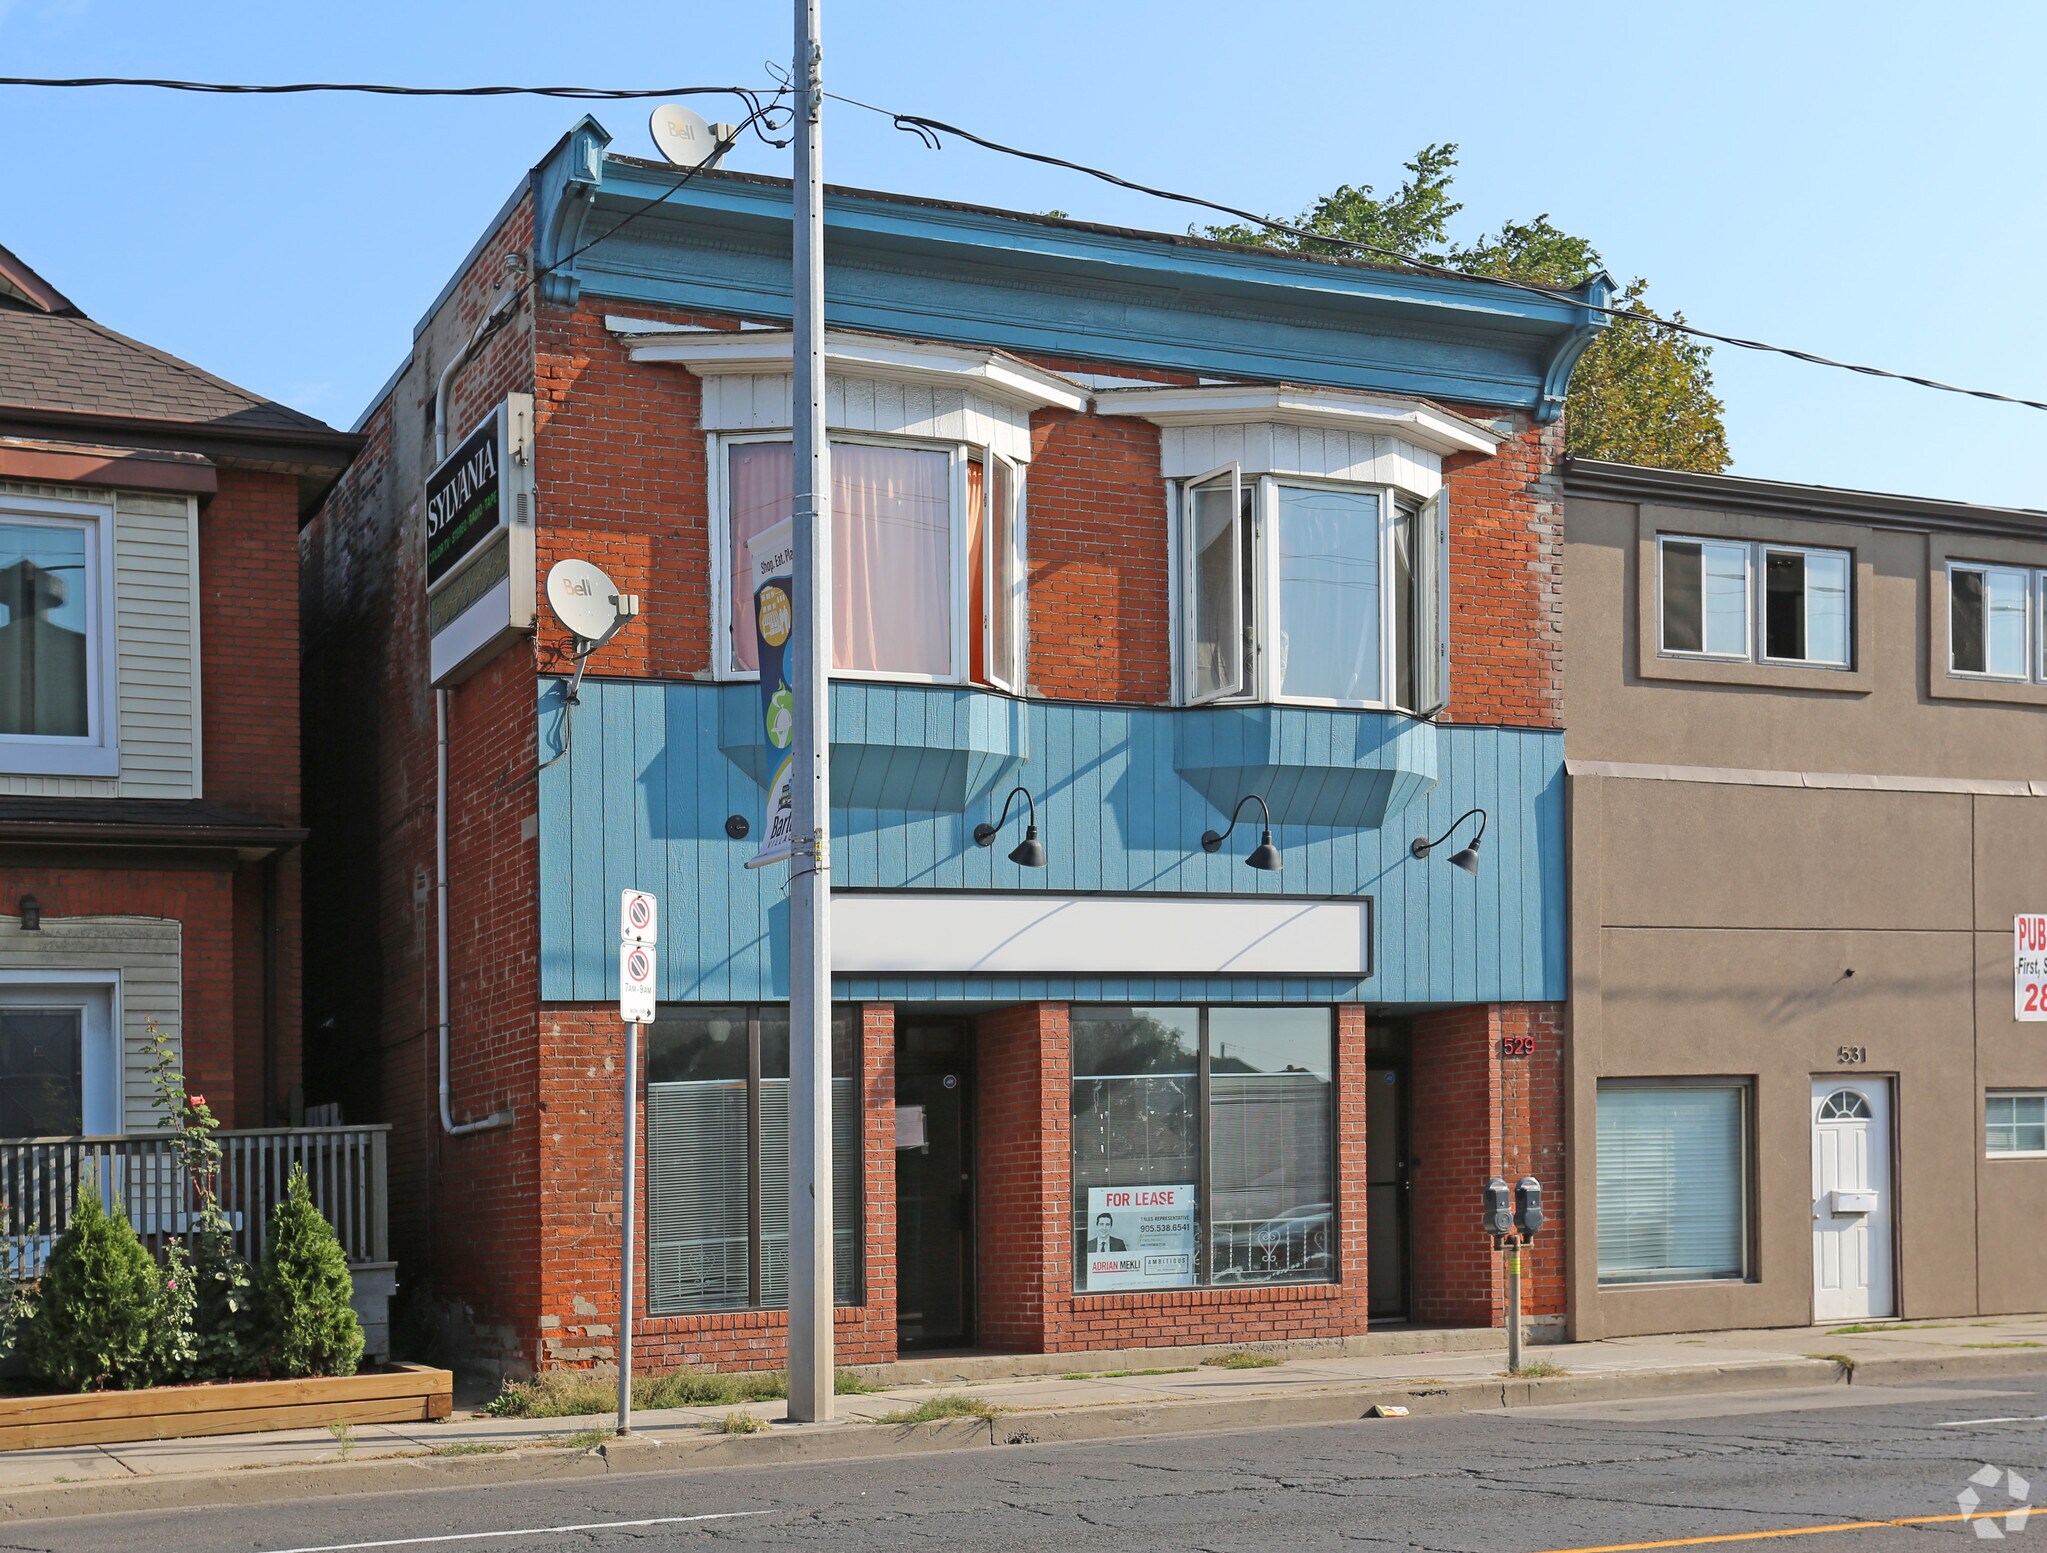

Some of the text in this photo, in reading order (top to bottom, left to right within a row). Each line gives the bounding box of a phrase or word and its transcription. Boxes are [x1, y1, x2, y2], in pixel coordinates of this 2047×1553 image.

[667, 120, 695, 141] Bell
[428, 439, 497, 539] SYLVANIA
[760, 560, 775, 575] Shop.
[774, 552, 785, 568] Eat.
[562, 577, 593, 597] Bell
[2018, 917, 2047, 951] PUB
[2017, 957, 2040, 978] First,
[1503, 1036, 1536, 1055] 529
[1838, 1045, 1867, 1064] 531
[1106, 1191, 1175, 1207] FOR LEASE
[1140, 1223, 1190, 1233] 905.538.6541
[1092, 1260, 1141, 1271] ADRIAN MEKLI
[1148, 1257, 1186, 1265] AMBITIOUS
